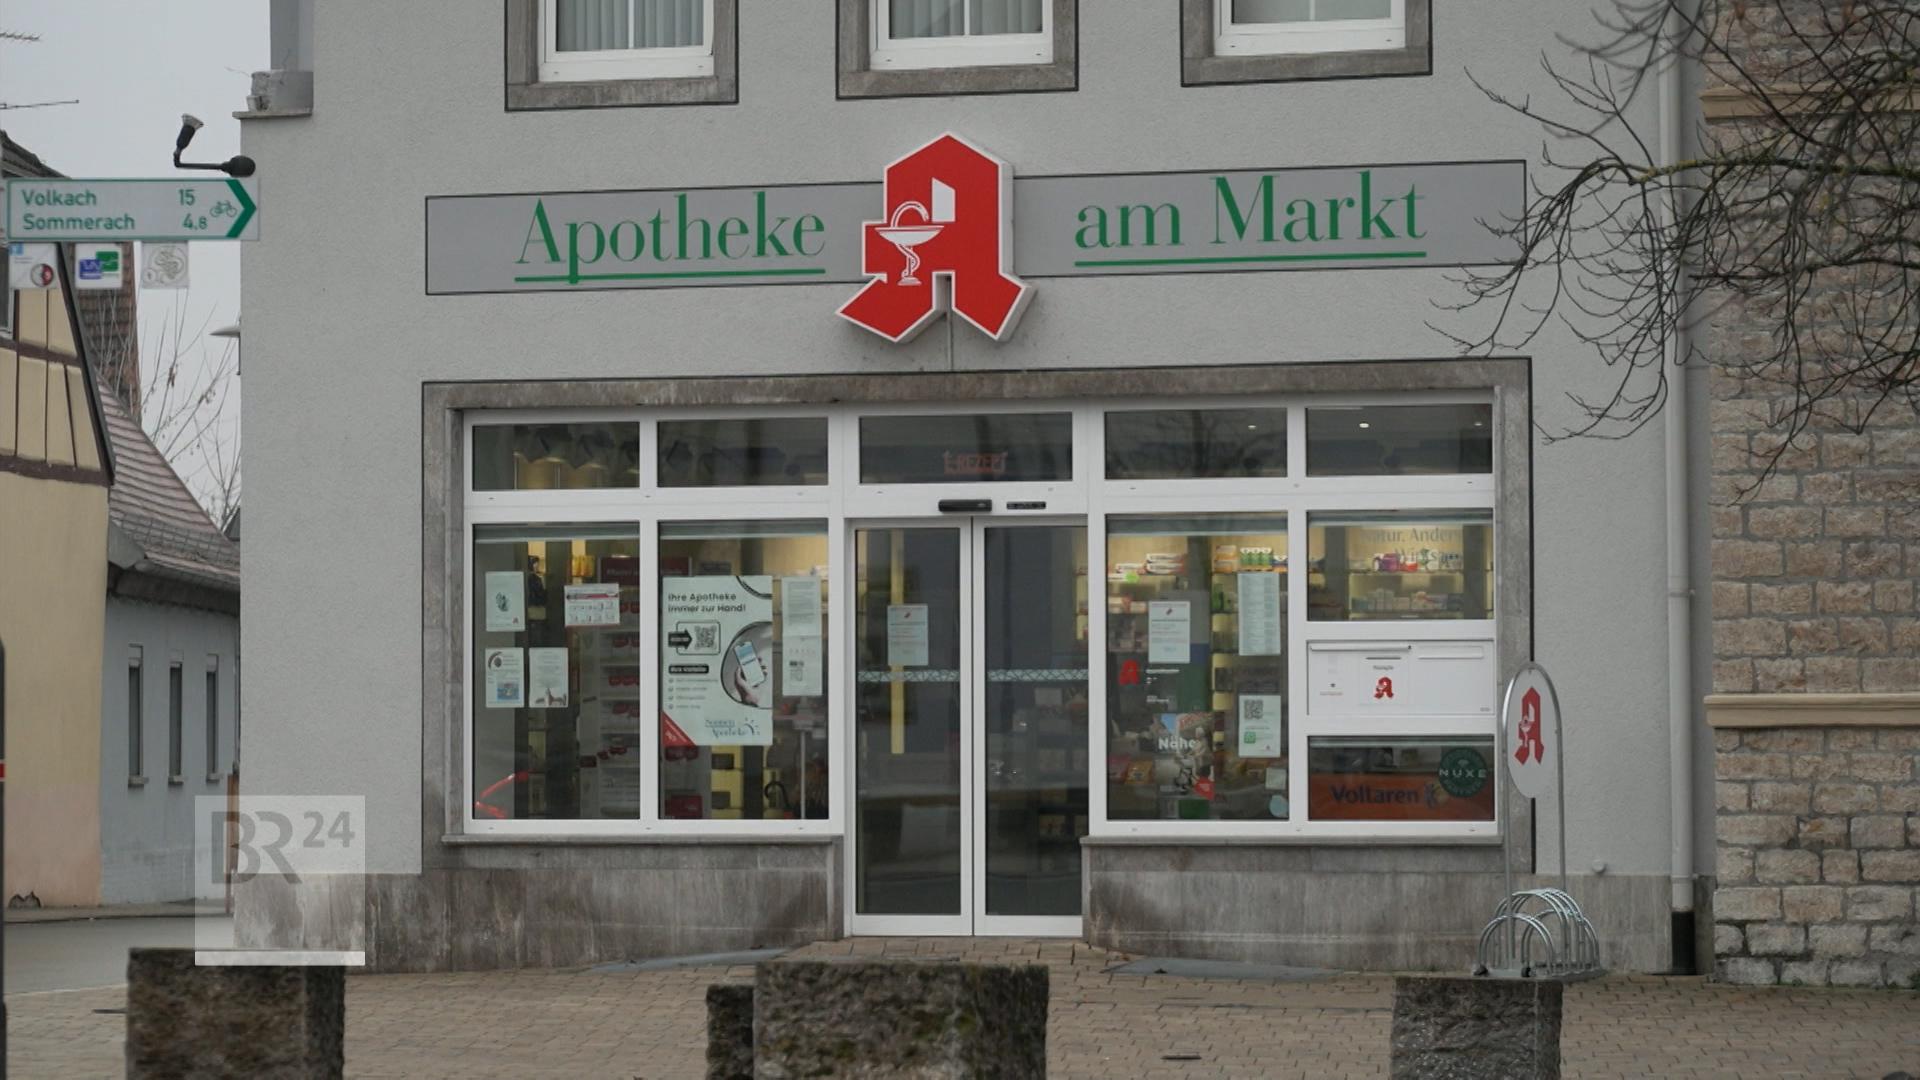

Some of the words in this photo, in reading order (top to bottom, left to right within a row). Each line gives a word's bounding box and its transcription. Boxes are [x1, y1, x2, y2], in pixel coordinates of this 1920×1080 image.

[22, 189, 97, 206] Volkach
[179, 189, 195, 206] 15
[22, 213, 135, 230] Sommerach
[514, 190, 826, 285] Apotheke
[1075, 200, 1184, 249] am
[1209, 169, 1428, 245] Markt
[668, 592, 687, 602] Ihre
[689, 592, 737, 603] Apotheke
[717, 603, 746, 613] Hand!
[1438, 768, 1487, 778] NUXE
[1330, 783, 1418, 804] Voltaren
